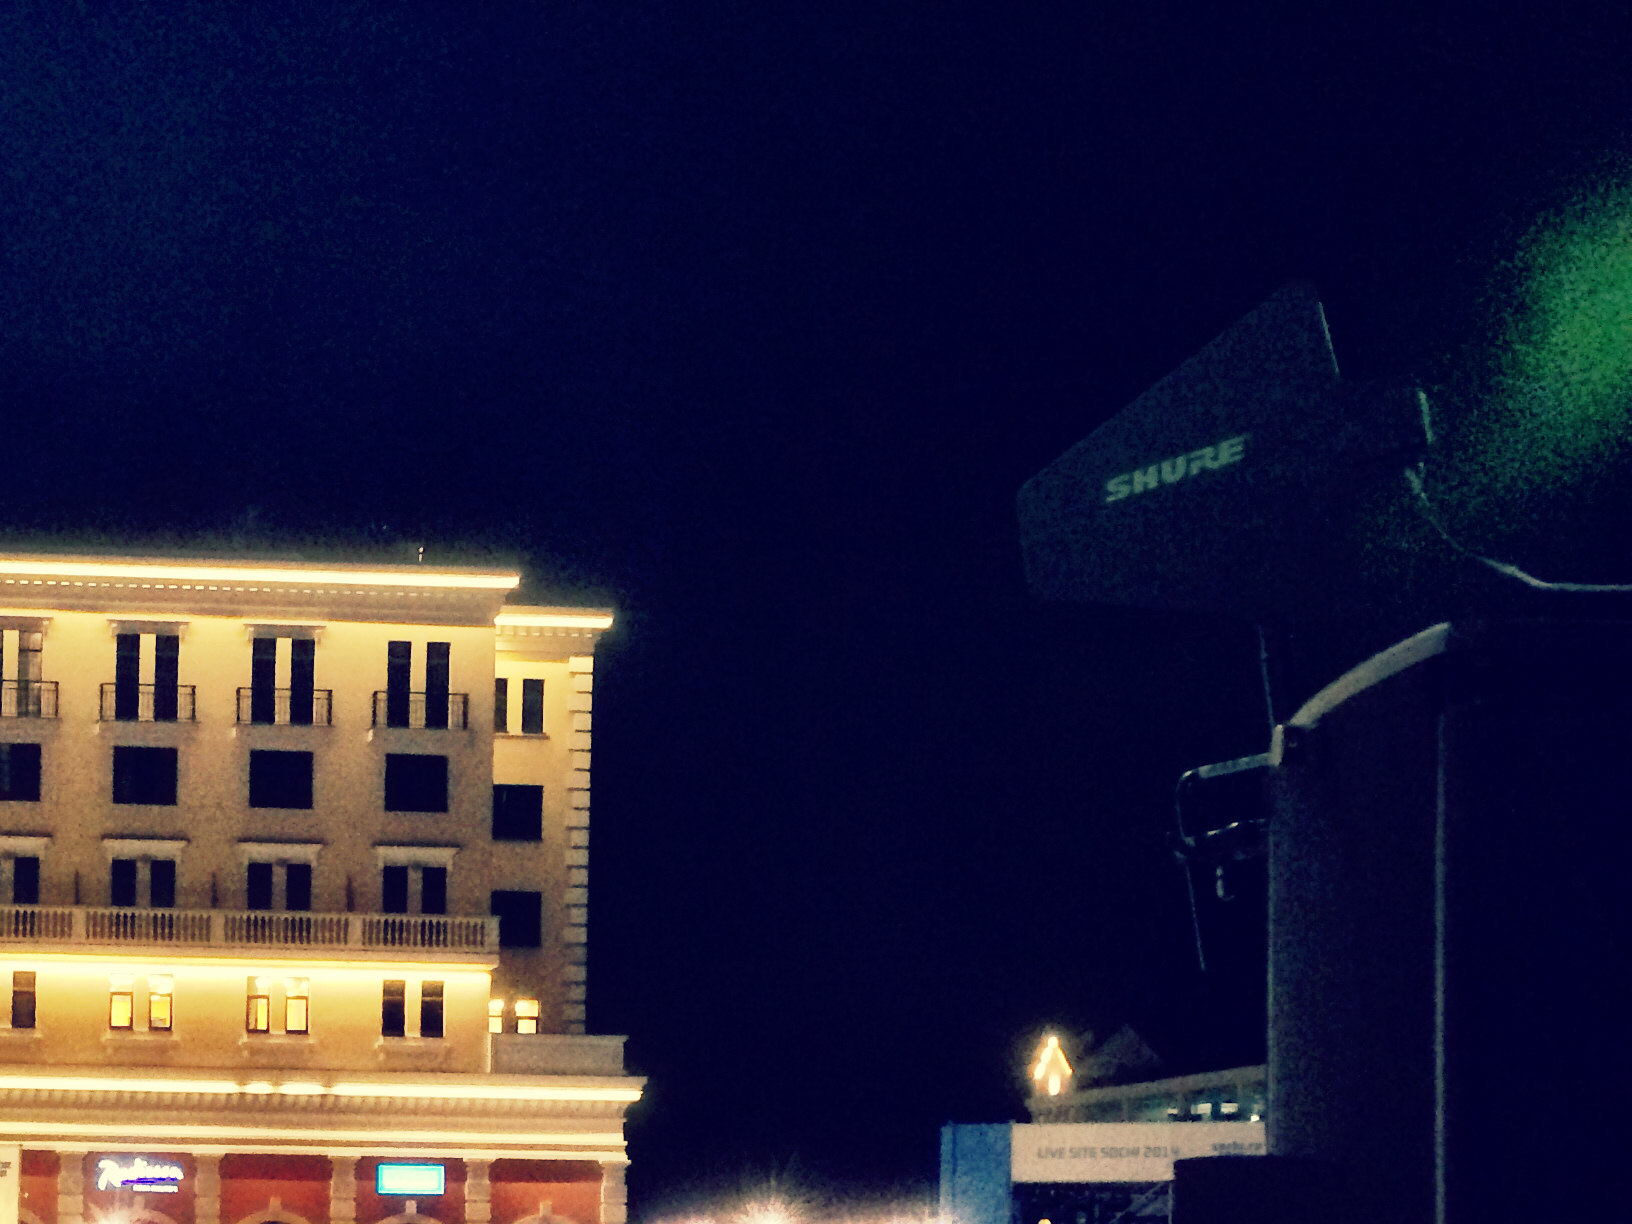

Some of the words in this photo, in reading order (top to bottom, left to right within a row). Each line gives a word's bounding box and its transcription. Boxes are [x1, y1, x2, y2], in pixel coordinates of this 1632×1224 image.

[1106, 435, 1247, 502] SHURE
[1037, 1146, 1065, 1159] LIVE
[1068, 1146, 1097, 1159] SITE
